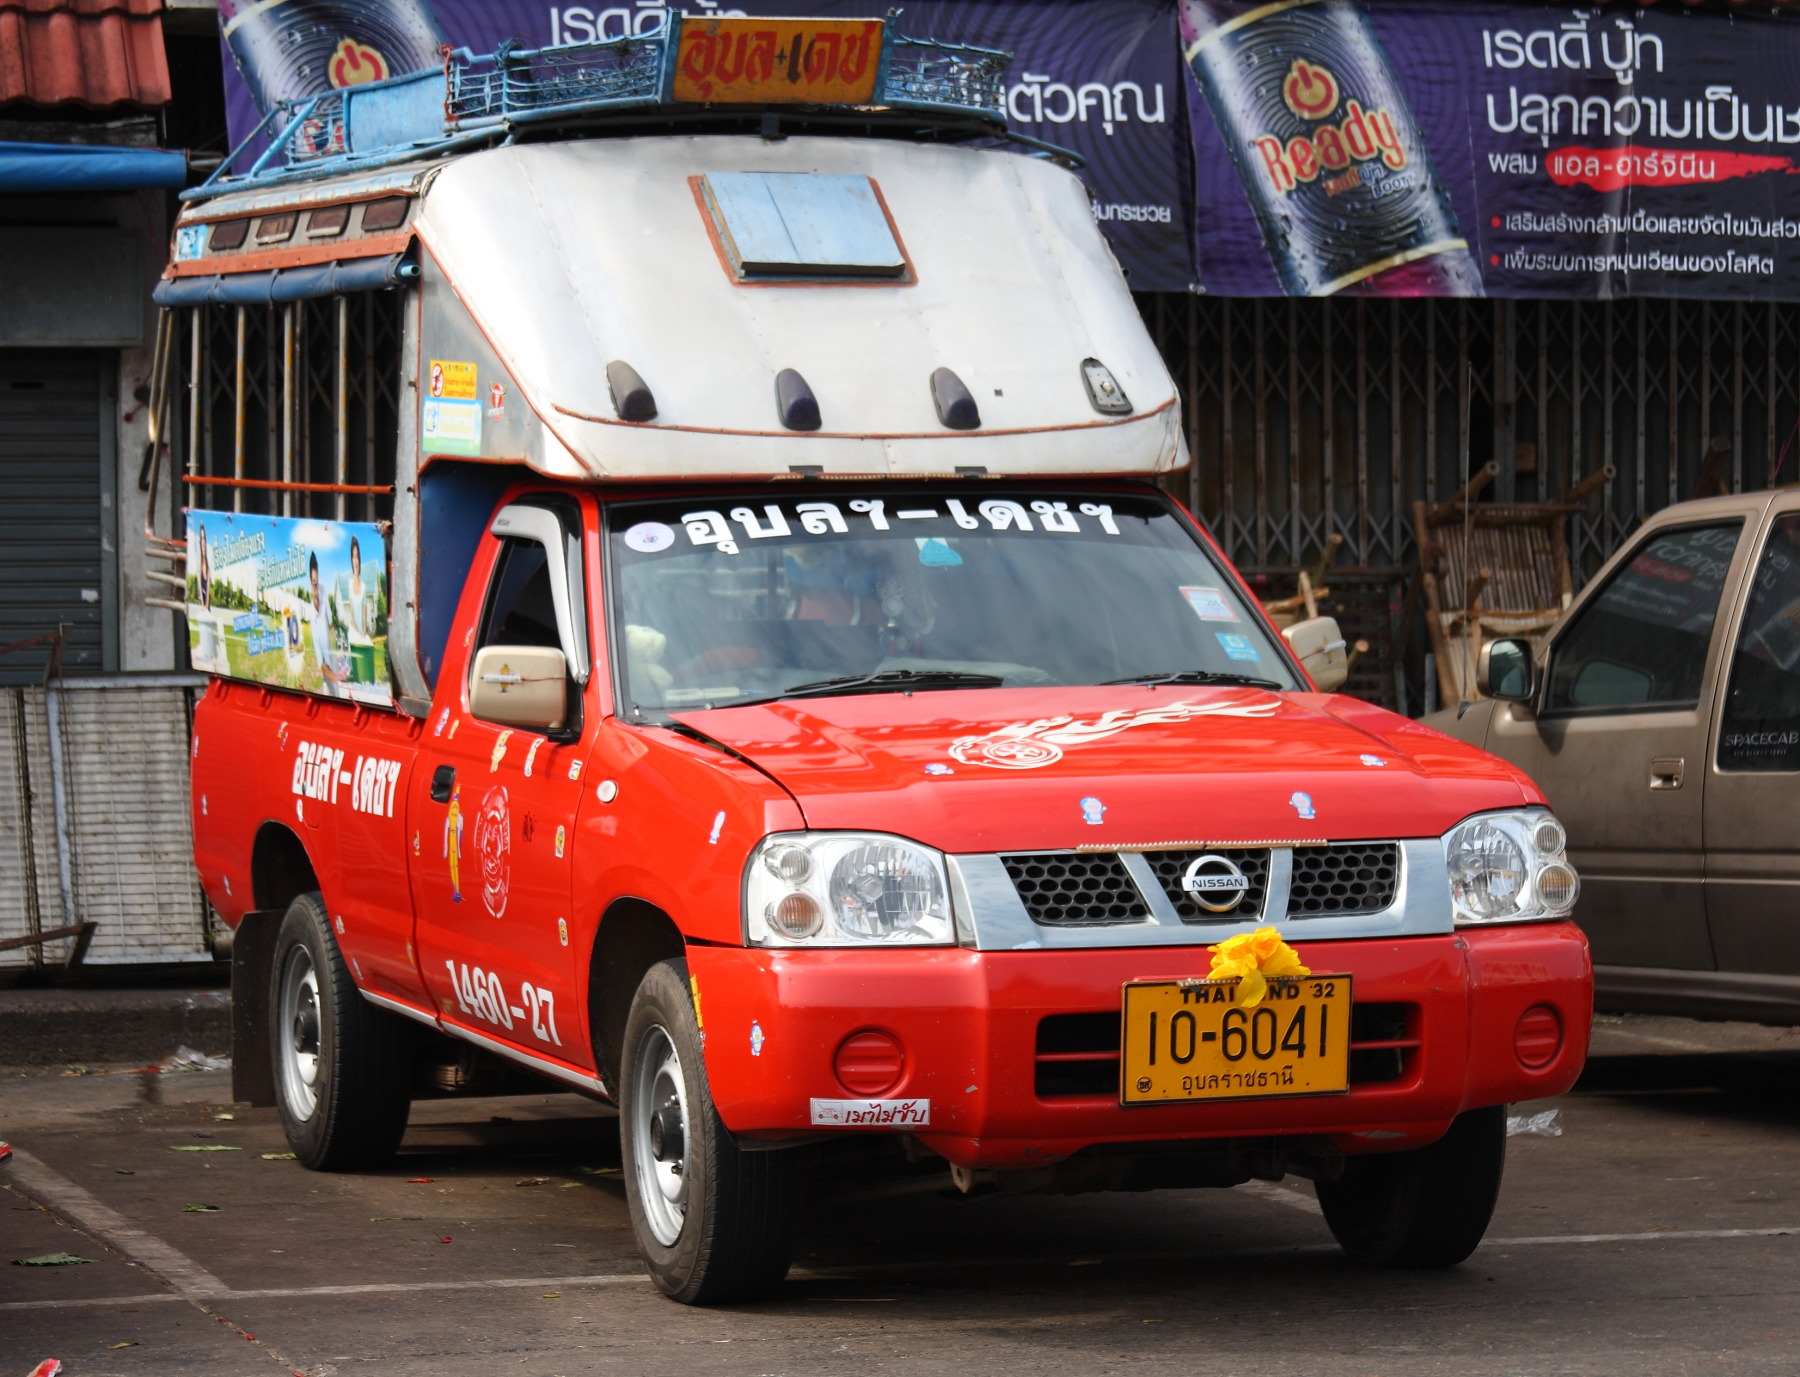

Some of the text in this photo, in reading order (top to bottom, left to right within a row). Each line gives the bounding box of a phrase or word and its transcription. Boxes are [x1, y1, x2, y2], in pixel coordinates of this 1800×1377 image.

[551, 0, 667, 50] เรดดี
[1483, 9, 1591, 69] เรดดี้
[1000, 73, 1166, 135] ตัวคุณ
[1254, 100, 1408, 196] Ready
[1487, 152, 1537, 176] ผสม
[1505, 207, 1800, 239] เสริมสร้างกล้ามเนื้อและขจัดไขมันส่ว
[1725, 731, 1799, 747] SPACECAB
[1192, 878, 1244, 888] NISSAN
[445, 959, 562, 1047] 1460-27
[1180, 983, 1300, 1004] THAIND
[1149, 1003, 1328, 1065] 10-6041
[1181, 1065, 1294, 1095] อุบลราชธานี
[845, 1100, 927, 1124] เมาไม่ขับ
